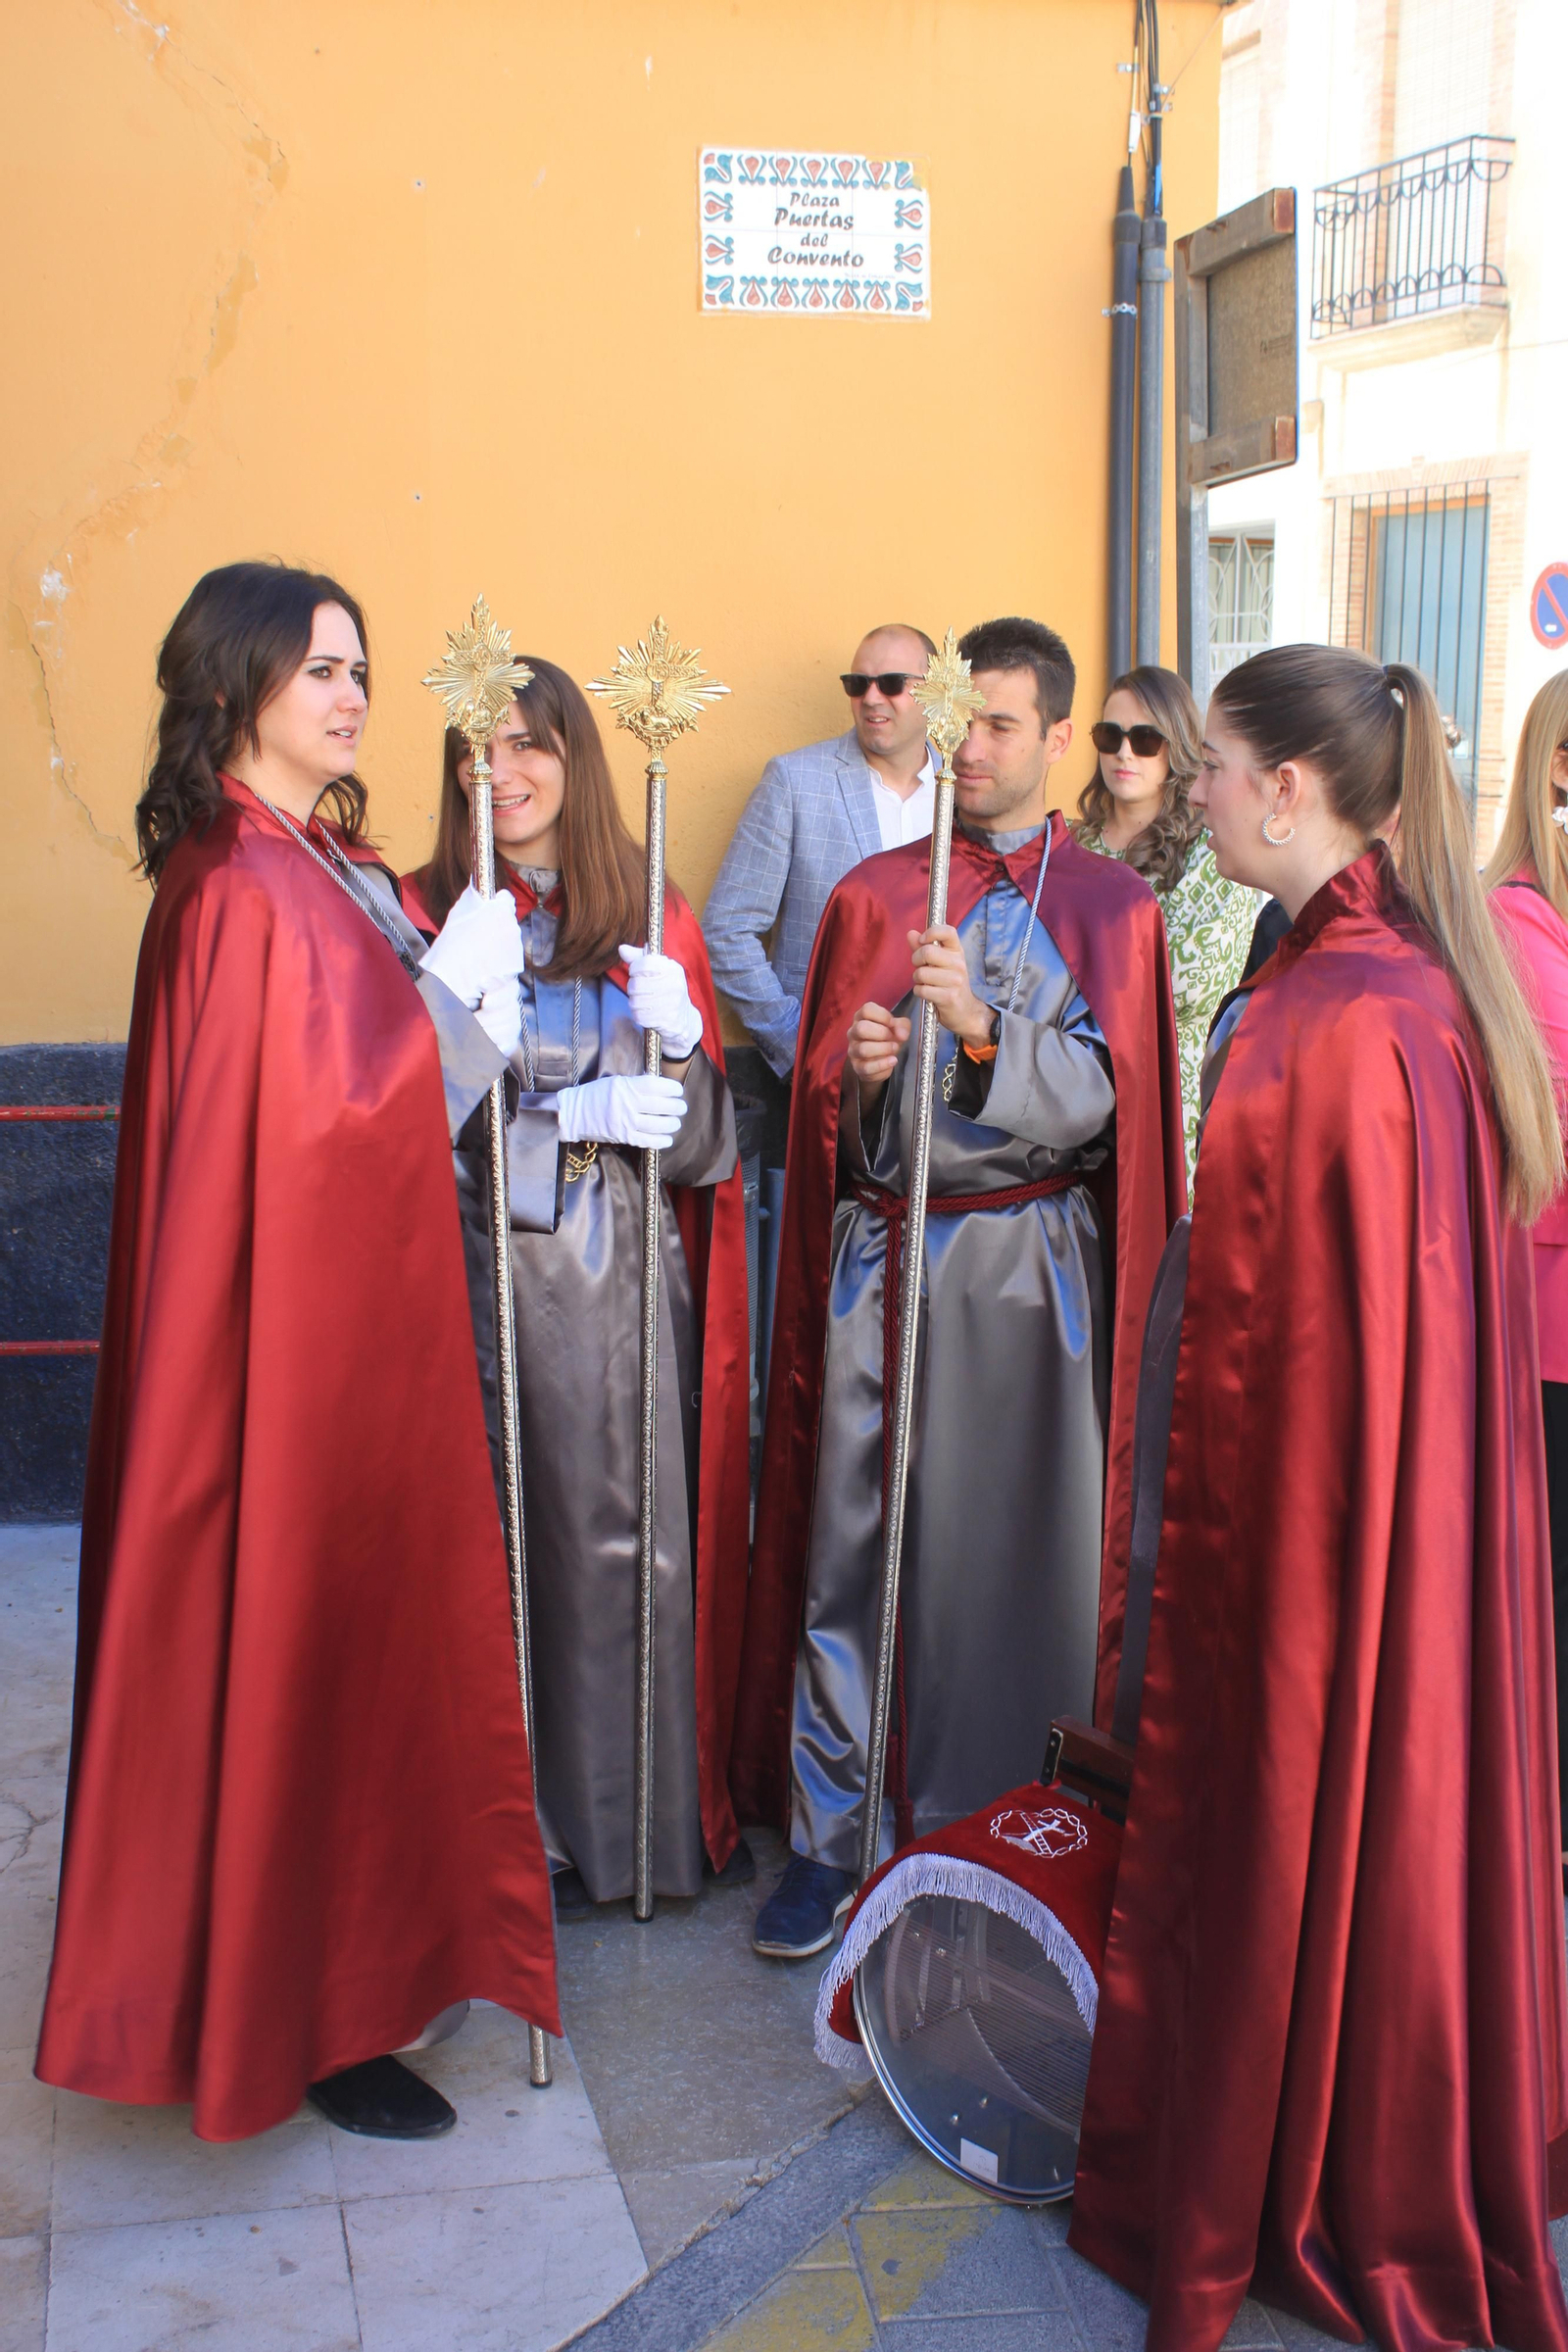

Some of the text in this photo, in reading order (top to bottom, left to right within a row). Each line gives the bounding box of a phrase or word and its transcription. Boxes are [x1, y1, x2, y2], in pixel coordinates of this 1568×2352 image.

[789, 192, 841, 208] Plaza
[773, 207, 855, 231] Puertas
[800, 232, 829, 247] del
[767, 246, 864, 268] Convento
